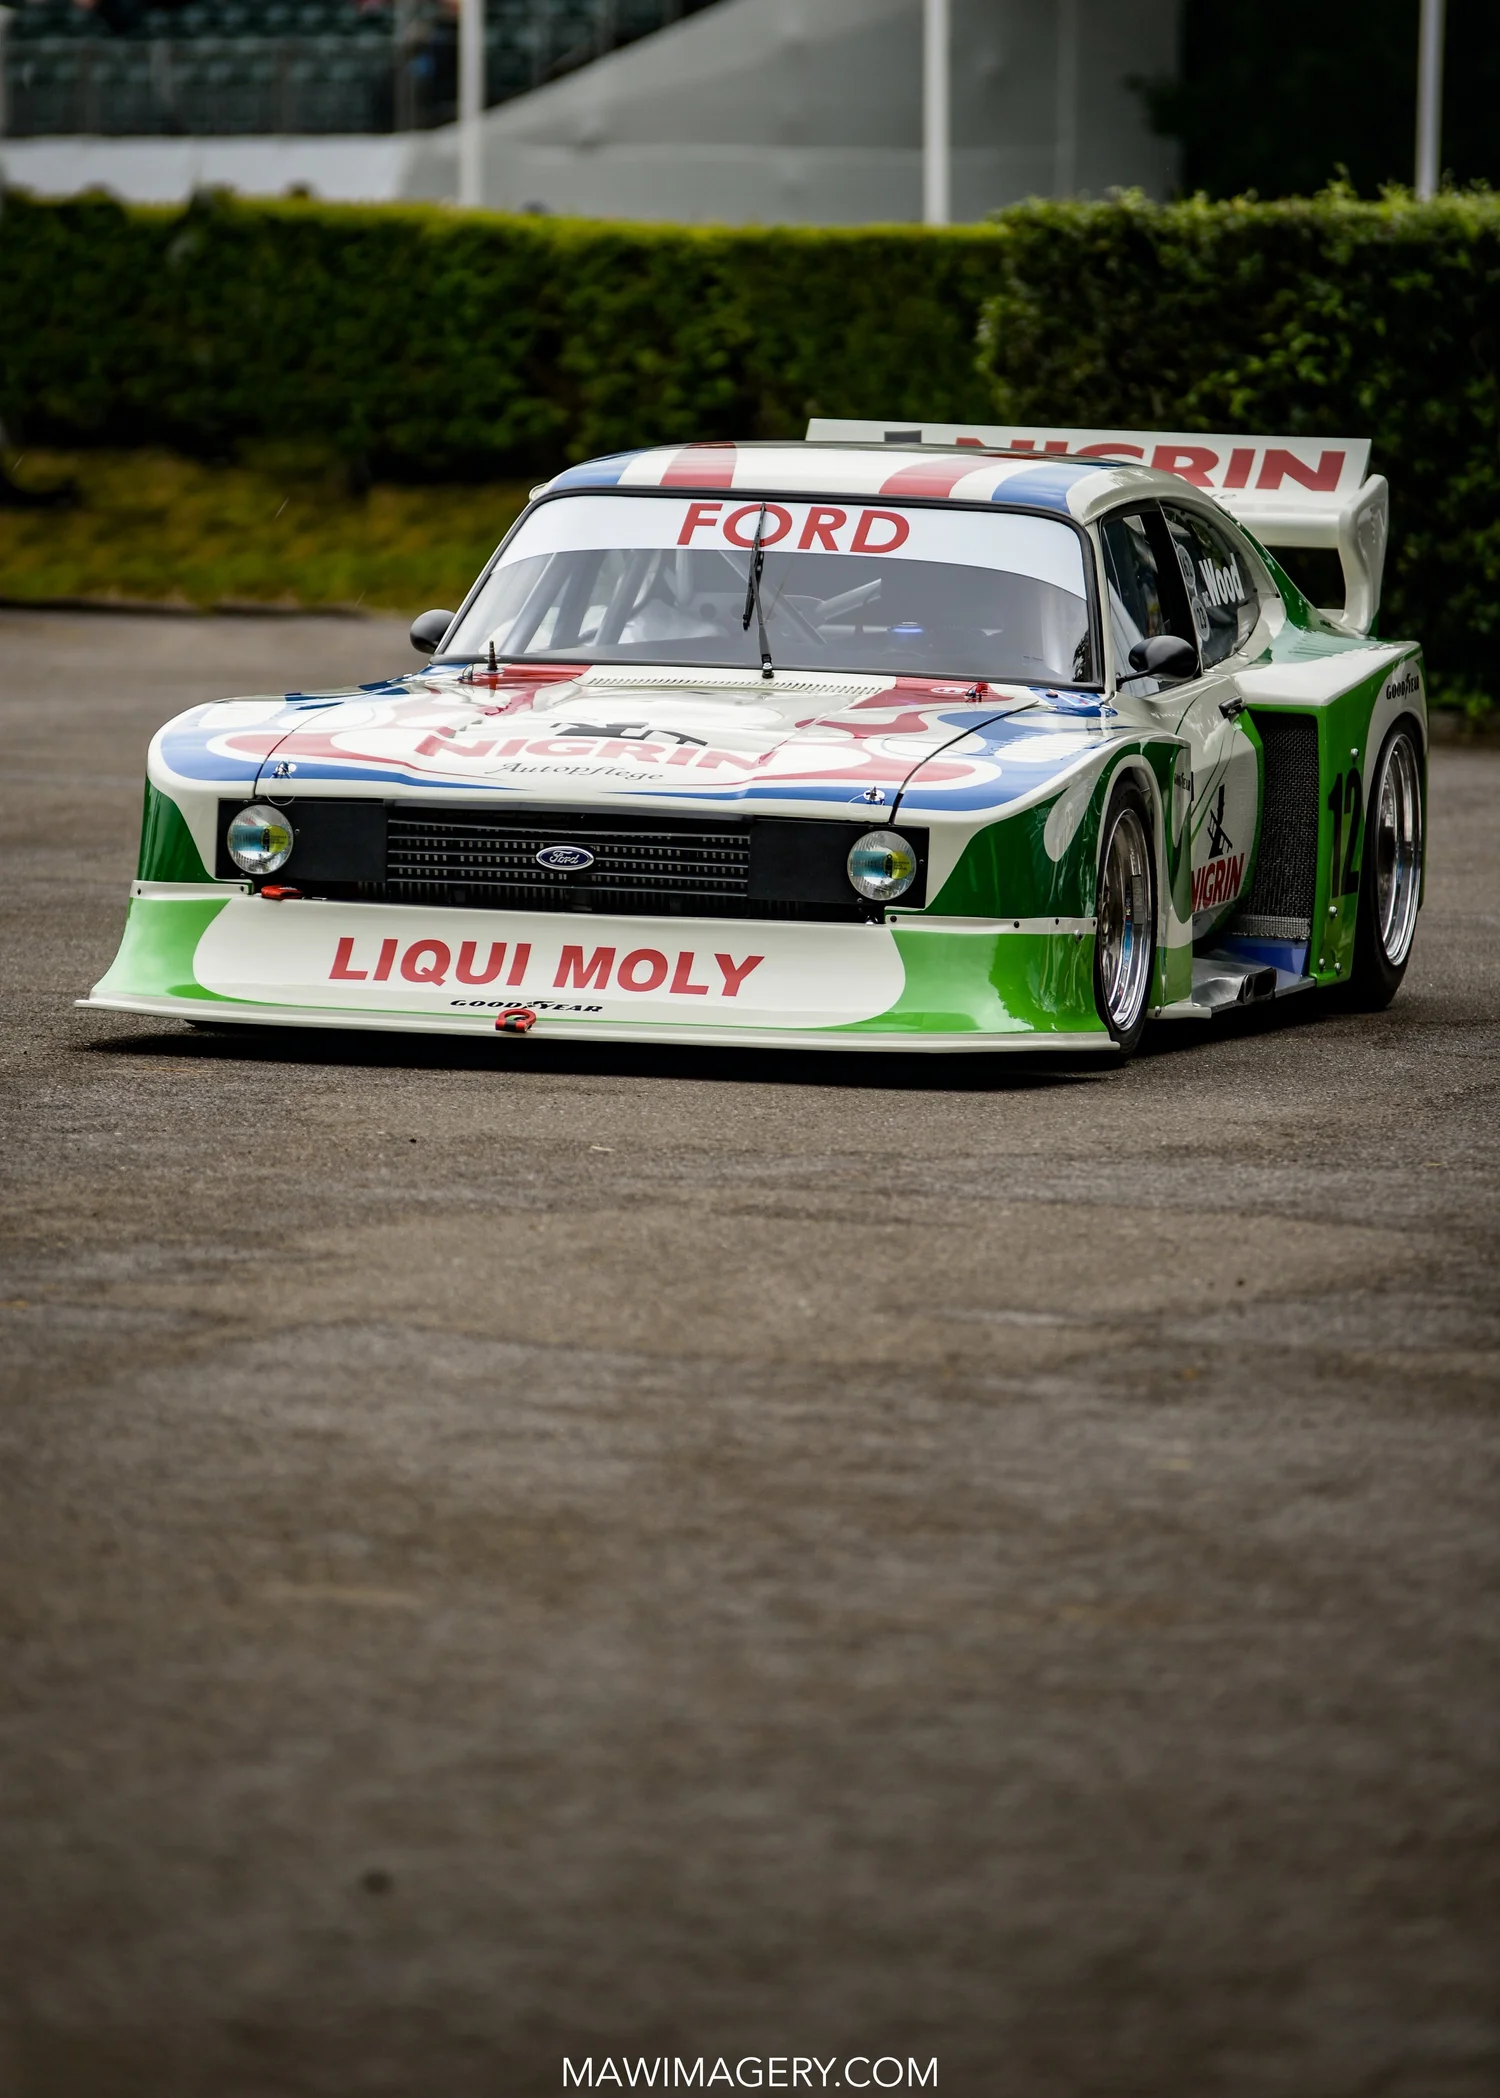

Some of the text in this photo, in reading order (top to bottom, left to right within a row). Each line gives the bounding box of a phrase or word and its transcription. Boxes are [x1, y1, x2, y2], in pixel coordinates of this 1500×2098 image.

[955, 437, 1347, 492] RIN
[677, 503, 909, 553] FORD
[1198, 553, 1245, 606] Wood
[413, 726, 778, 770] NIGRIN
[485, 762, 664, 781] Autopflege
[549, 850, 580, 864] Ford
[1328, 767, 1363, 899] 12
[1191, 853, 1245, 914] NIGRIN
[328, 937, 765, 997] LIQUI MOLY
[450, 1000, 603, 1012] GOODYEAR
